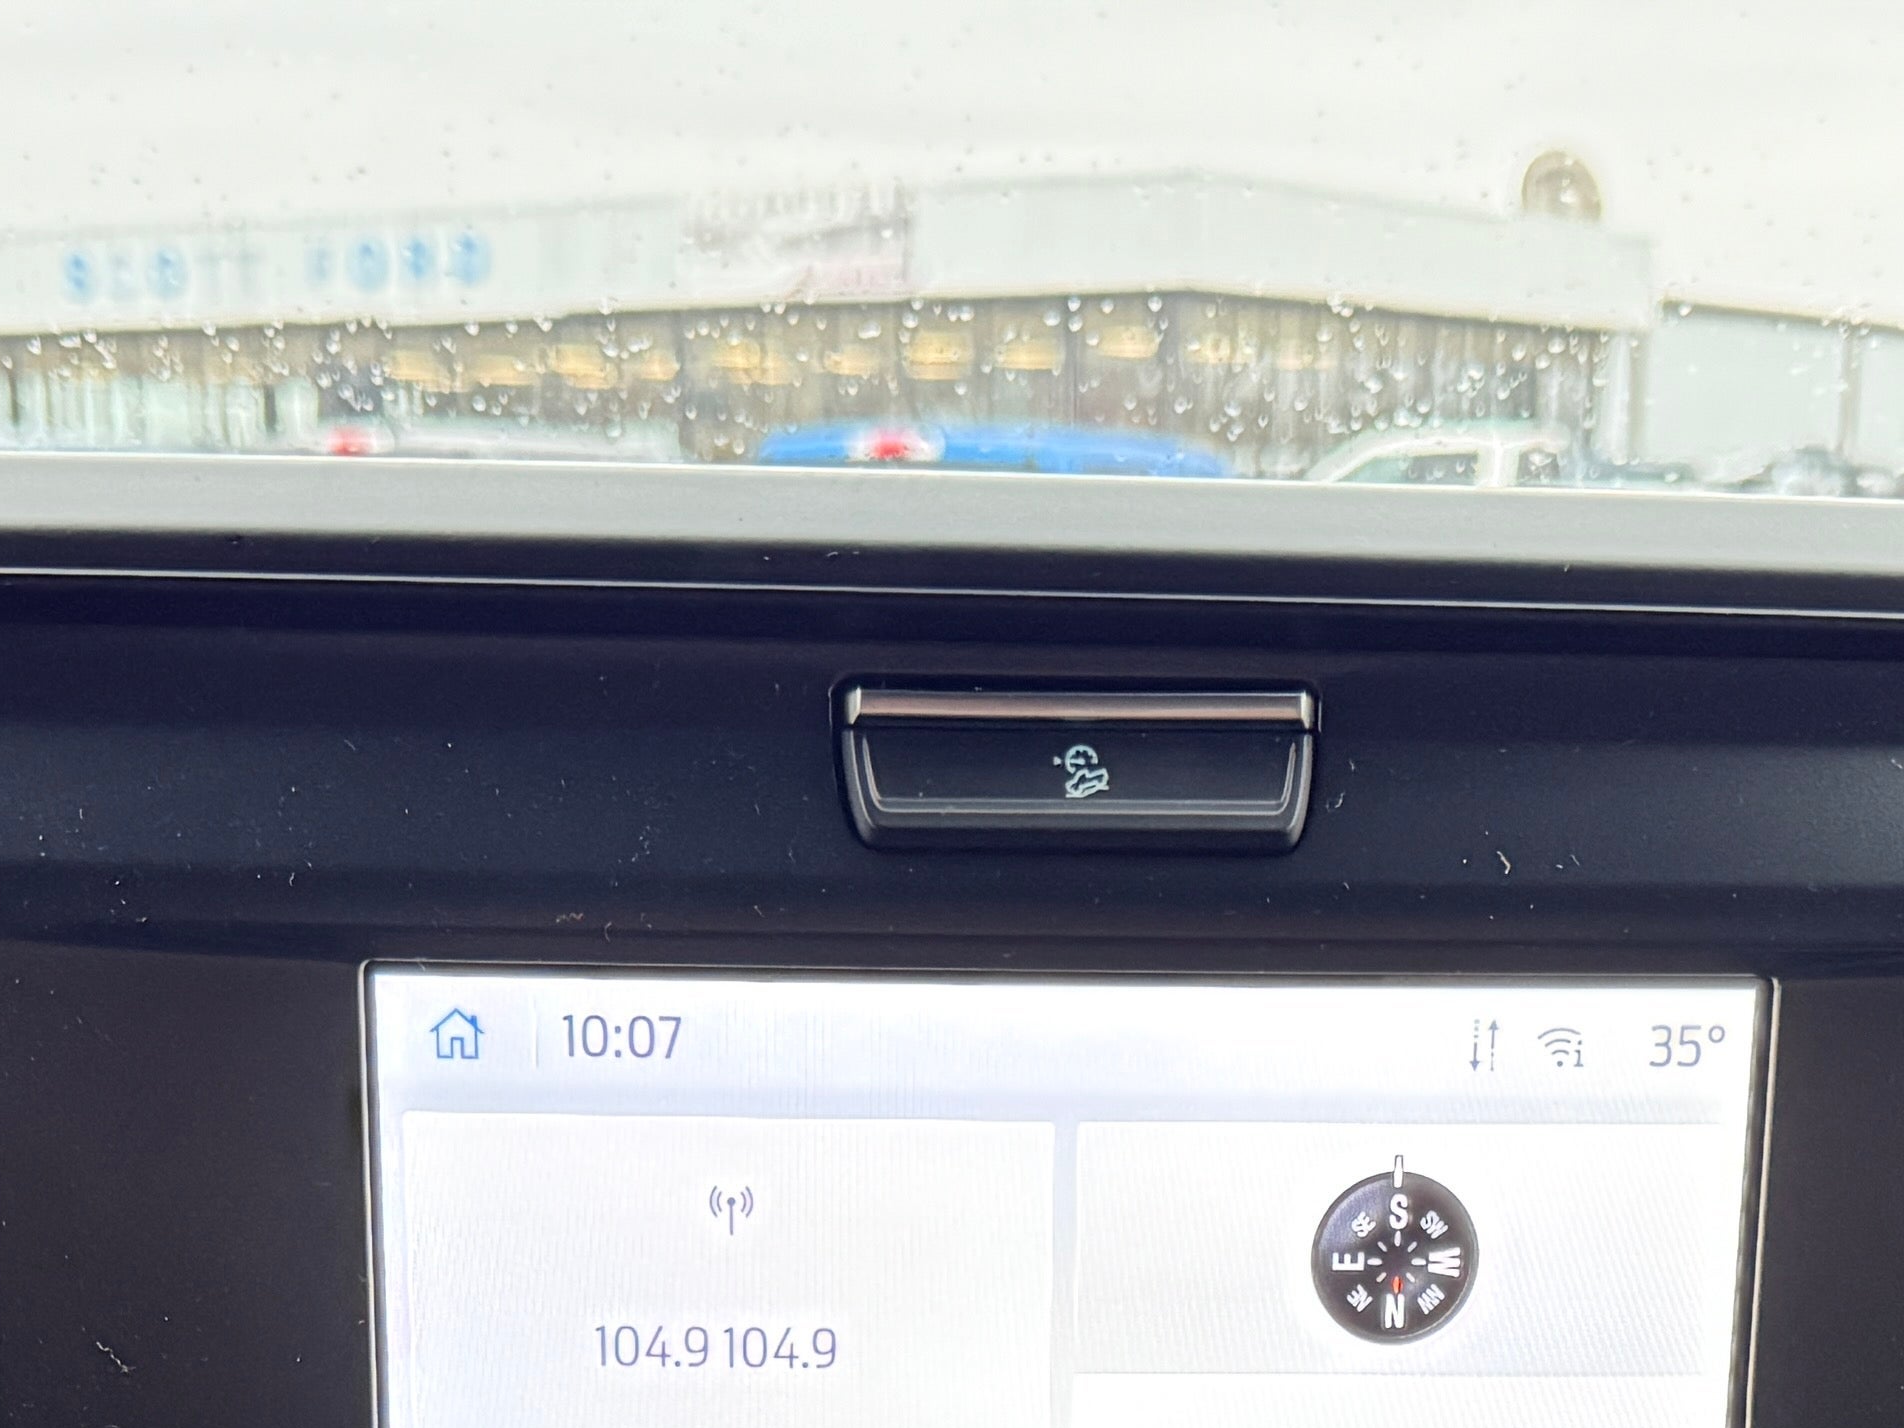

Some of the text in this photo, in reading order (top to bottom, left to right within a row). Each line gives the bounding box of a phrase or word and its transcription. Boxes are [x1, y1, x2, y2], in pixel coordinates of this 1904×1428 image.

[561, 1013, 683, 1060] 10:07
[1388, 1193, 1409, 1230] S
[1331, 1251, 1365, 1271] E
[1427, 1246, 1461, 1278] W
[1384, 1293, 1406, 1329] N
[593, 1324, 838, 1370] 104.9 104.9
